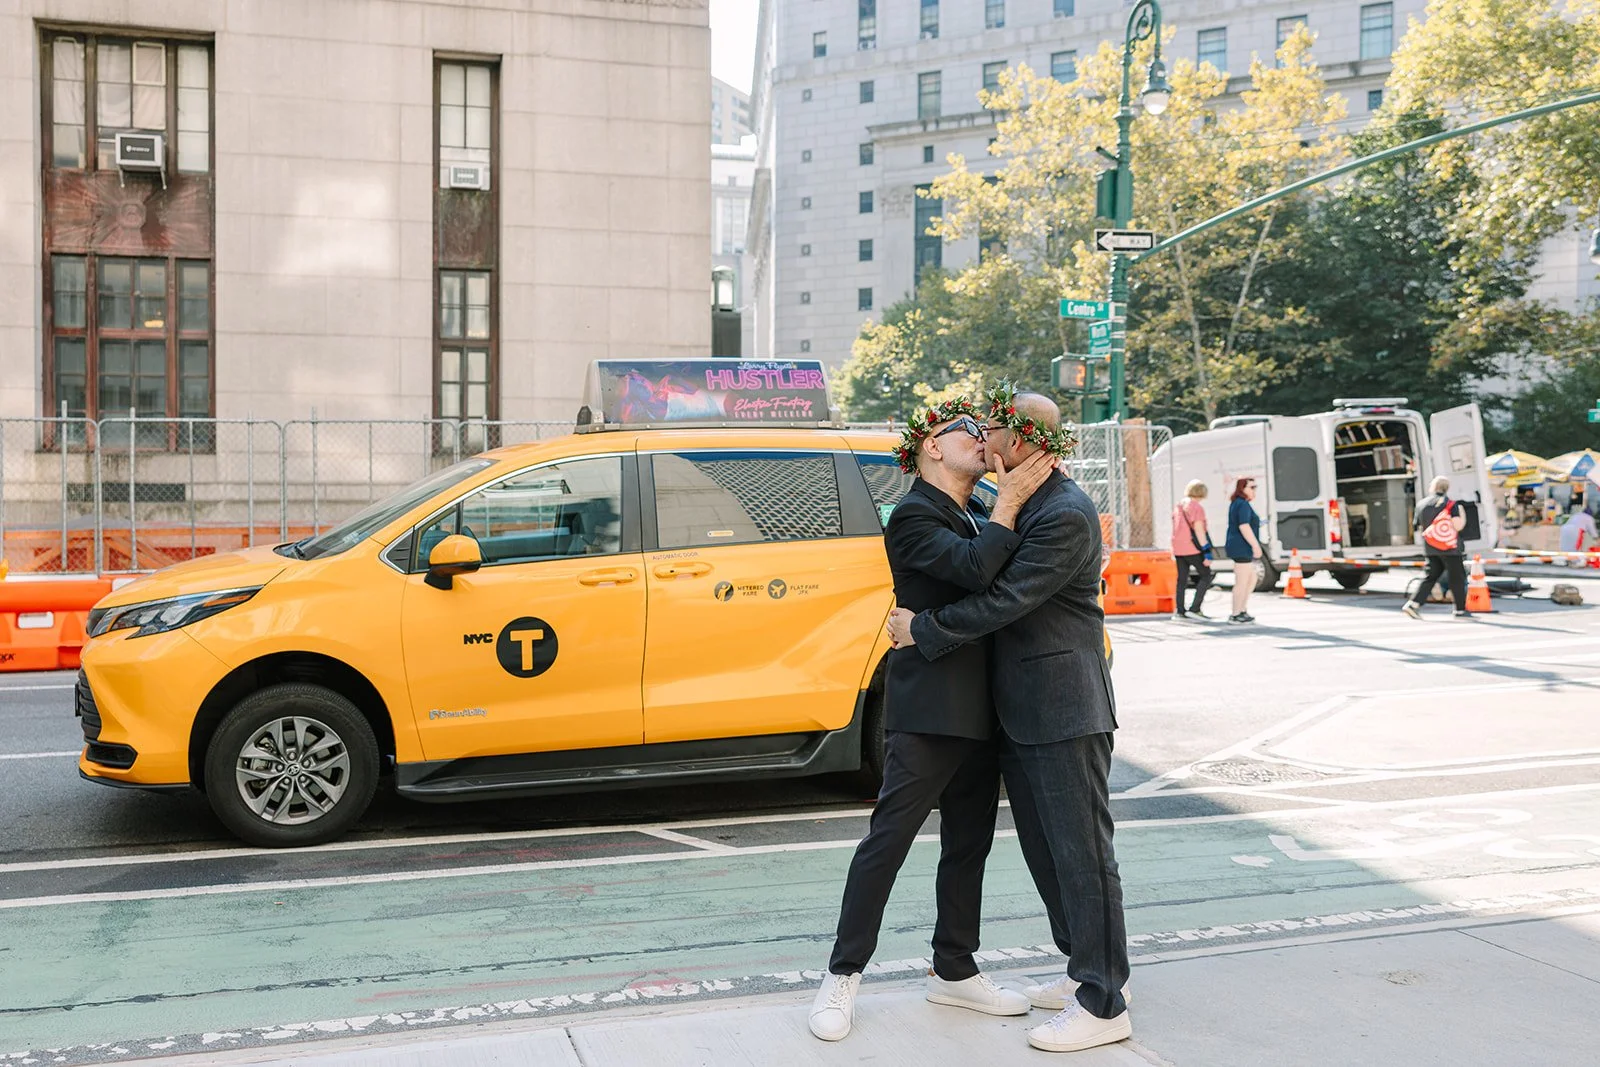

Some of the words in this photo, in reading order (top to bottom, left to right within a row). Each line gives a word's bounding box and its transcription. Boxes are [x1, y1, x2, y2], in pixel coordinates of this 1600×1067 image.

[1104, 237, 1121, 246] ONE
[1067, 301, 1096, 317] Centre
[706, 369, 824, 390] HUSTLER
[734, 397, 772, 411] Electric
[770, 396, 813, 411] Fantasy
[652, 553, 682, 561] AUTOMATIC
[464, 634, 493, 645] NYC
[510, 629, 543, 671] T
